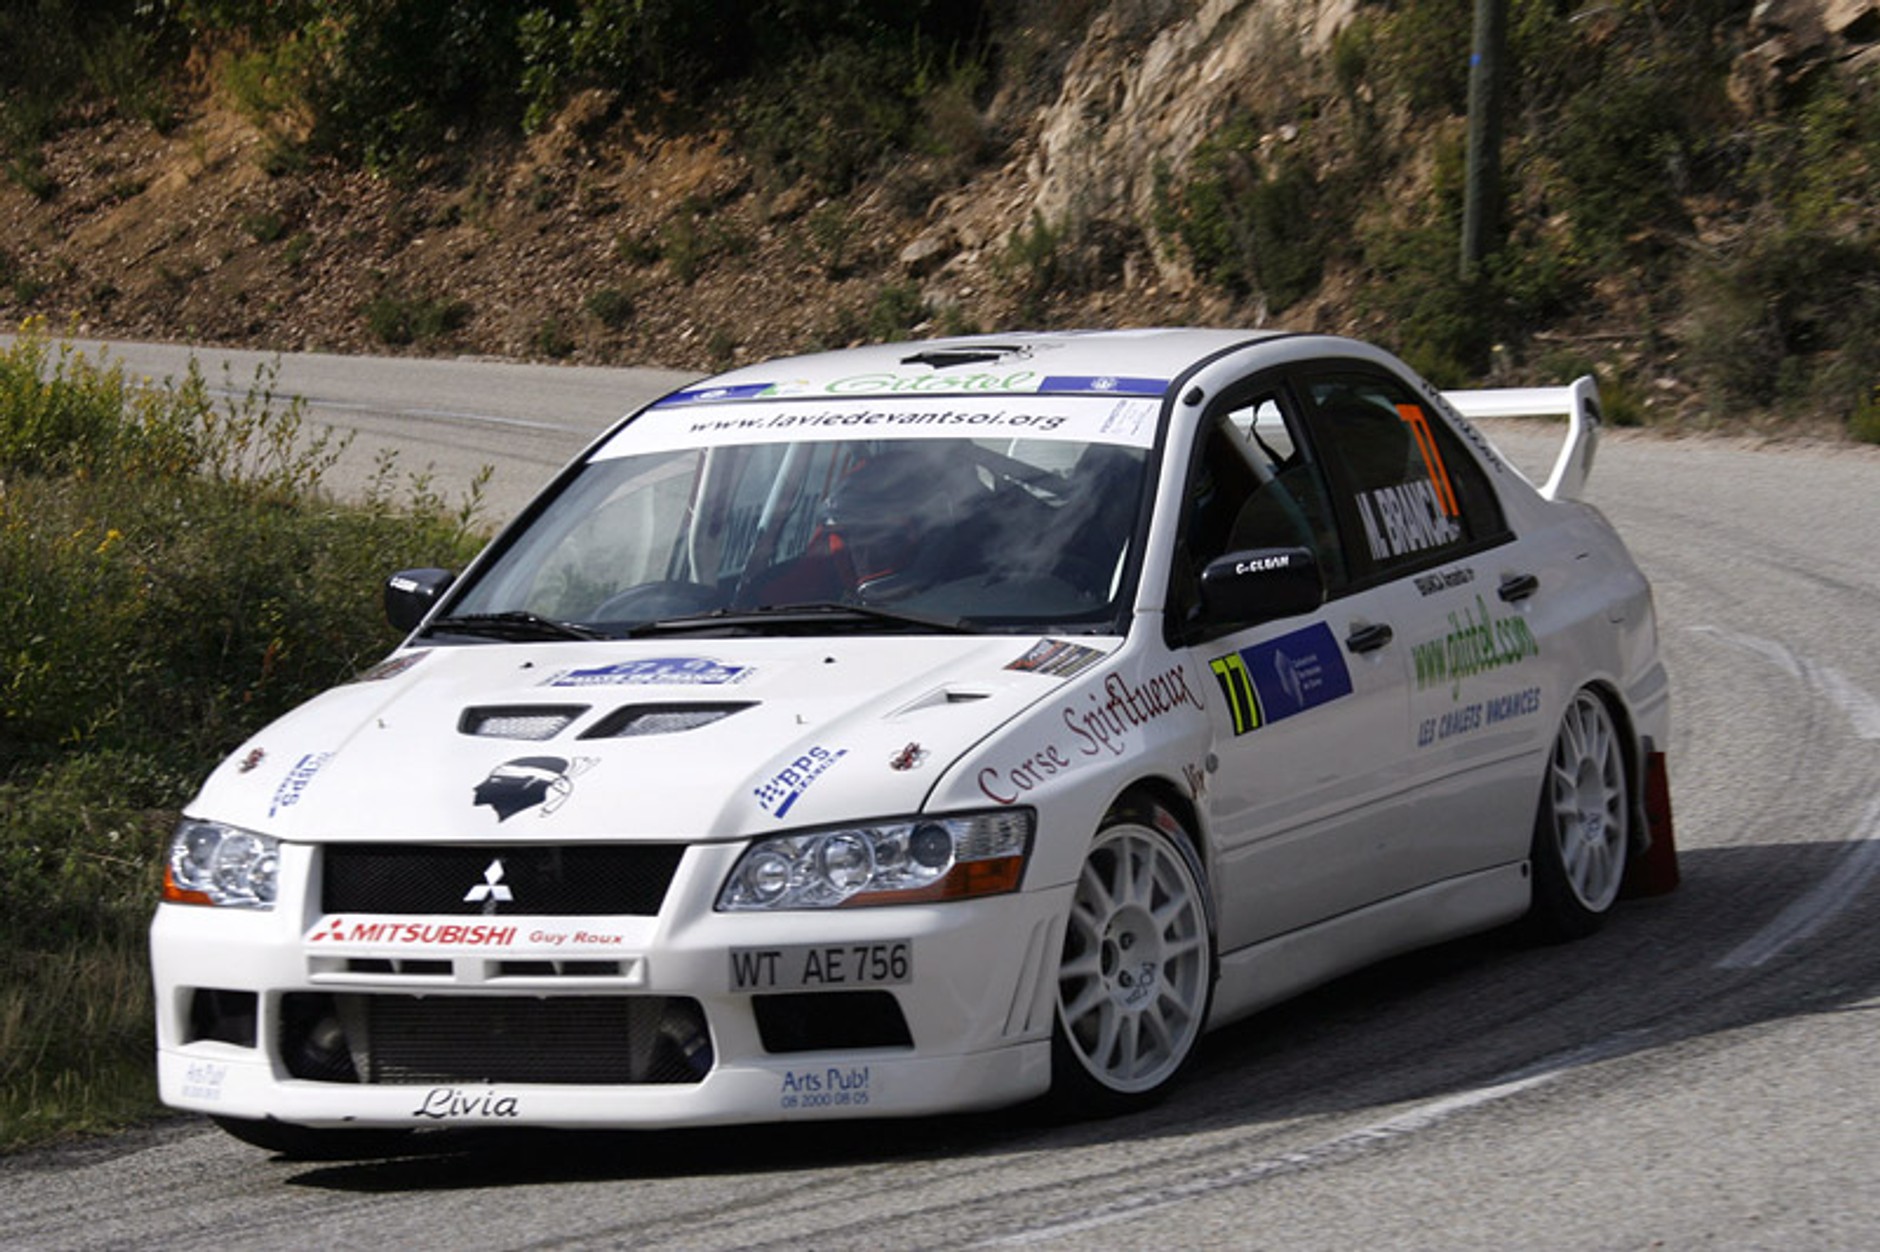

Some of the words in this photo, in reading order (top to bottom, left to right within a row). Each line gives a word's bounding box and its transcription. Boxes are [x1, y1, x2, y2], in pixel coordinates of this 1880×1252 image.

[689, 411, 1068, 433] www.laviedevantsoi.org
[1209, 651, 1264, 737] 77
[779, 745, 832, 788] BPS
[977, 744, 1070, 805] Corse
[349, 922, 518, 946] MITSUBISHI
[528, 929, 566, 945] Guy
[572, 930, 624, 945] Roux
[731, 950, 782, 988] WT
[801, 948, 846, 985] AE
[853, 943, 908, 981] 756
[780, 1071, 822, 1093] Arts
[827, 1066, 869, 1091] Pub!
[413, 1087, 519, 1119] Livia
